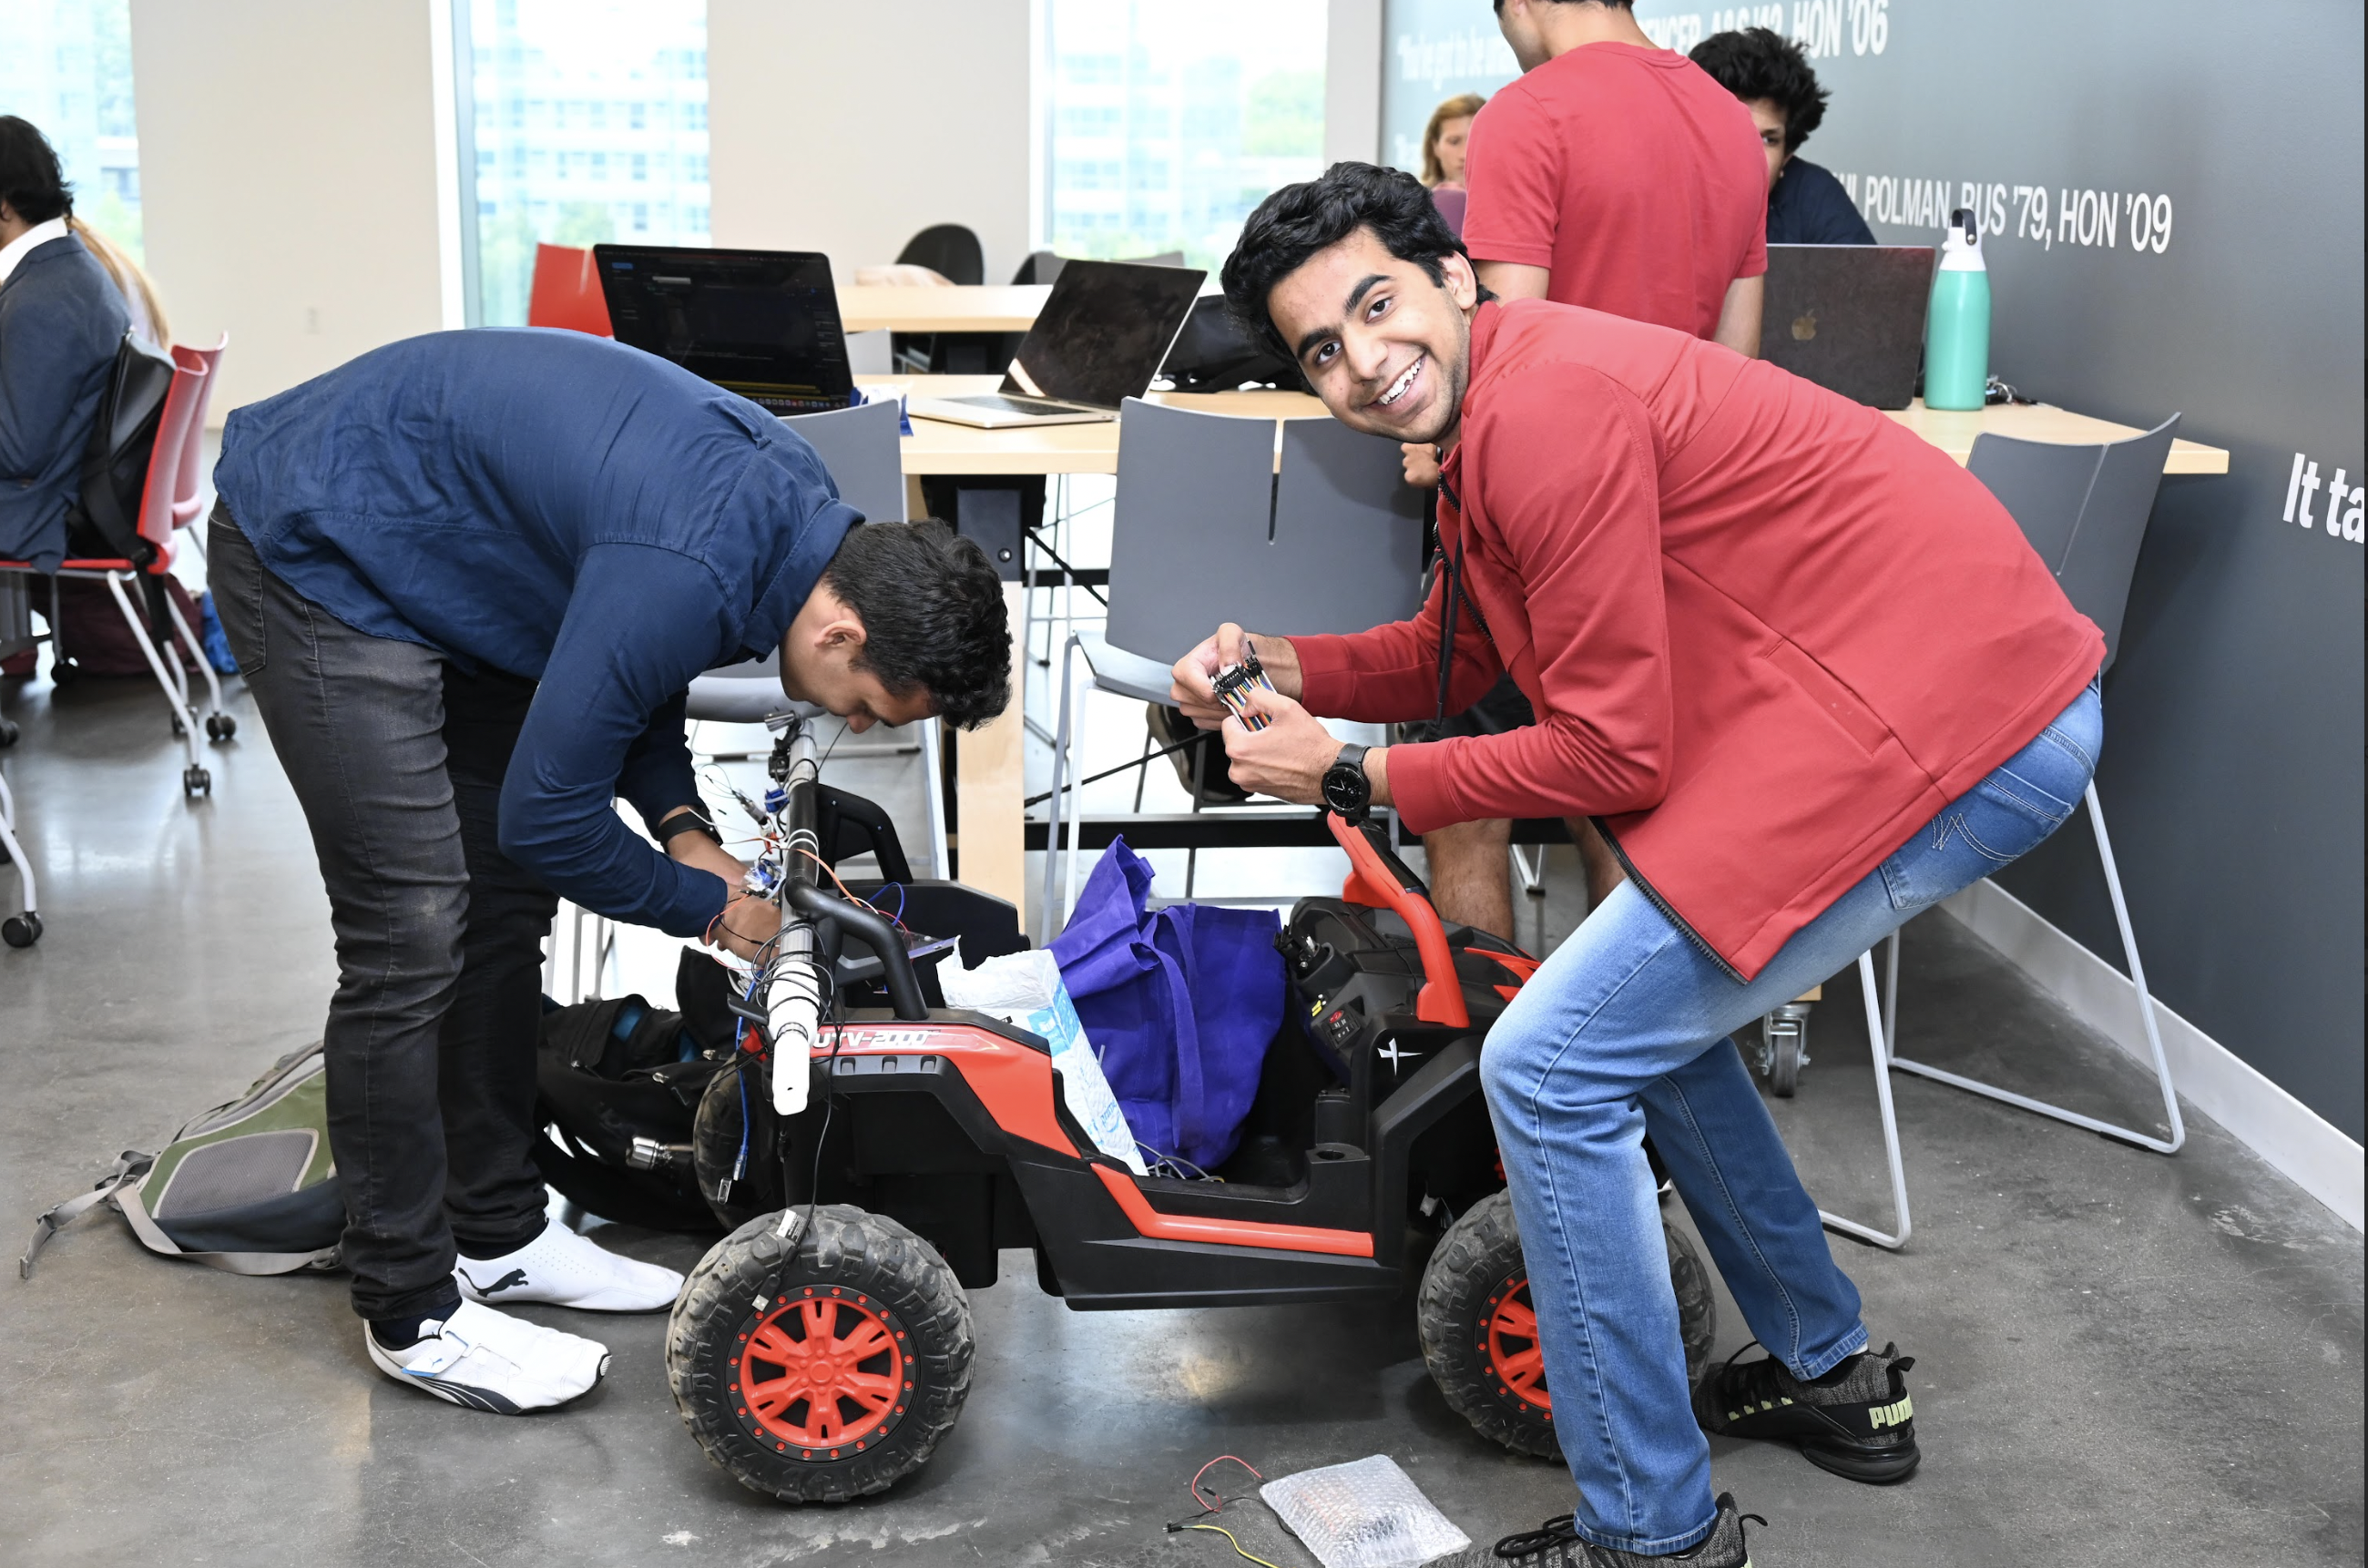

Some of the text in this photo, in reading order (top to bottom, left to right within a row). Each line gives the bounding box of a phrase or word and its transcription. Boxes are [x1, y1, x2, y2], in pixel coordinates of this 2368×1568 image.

[1792, 1, 1842, 58] HON
[2013, 186, 2051, 251] ’79,
[2059, 188, 2118, 248] HON
[2126, 192, 2172, 254] ’09
[2283, 453, 2321, 528] It
